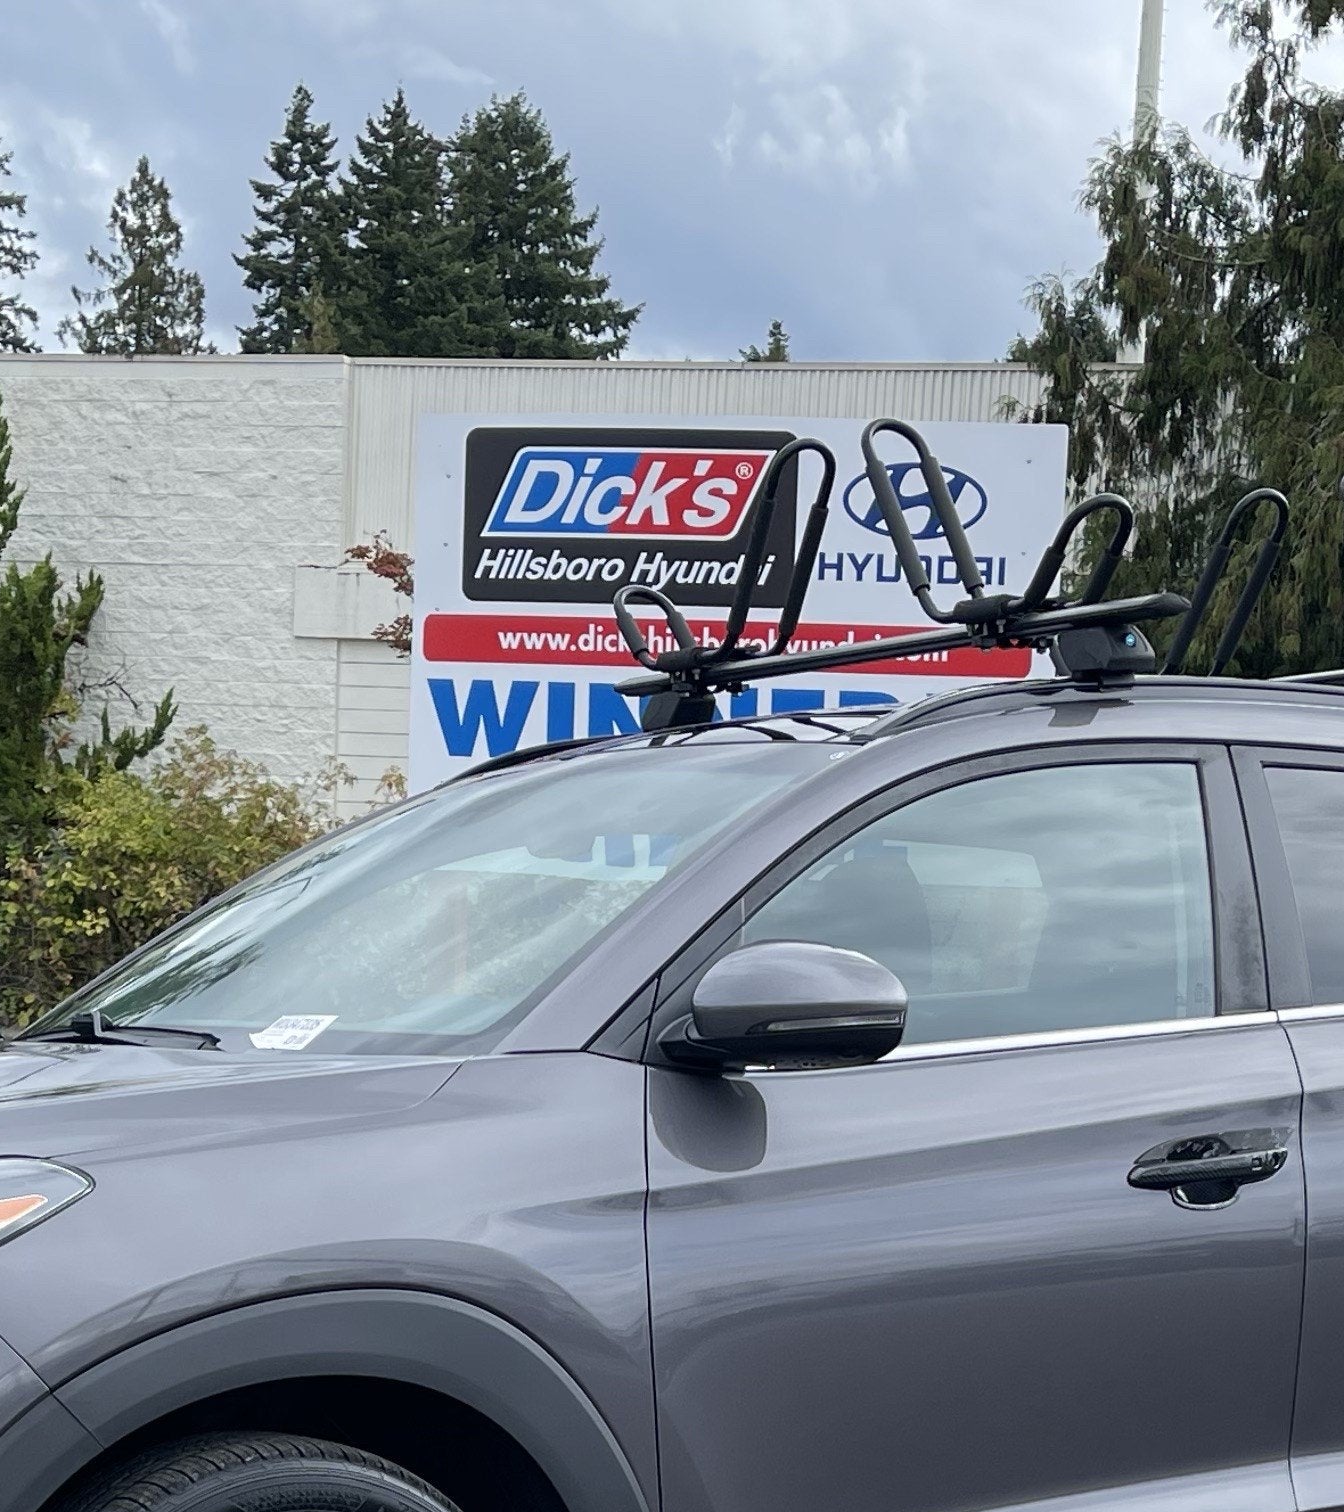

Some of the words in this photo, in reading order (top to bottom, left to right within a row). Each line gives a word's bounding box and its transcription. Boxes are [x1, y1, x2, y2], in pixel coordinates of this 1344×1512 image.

[504, 457, 739, 528] Dick's
[473, 548, 626, 582] Hillsboro
[629, 550, 776, 592] Hyundi
